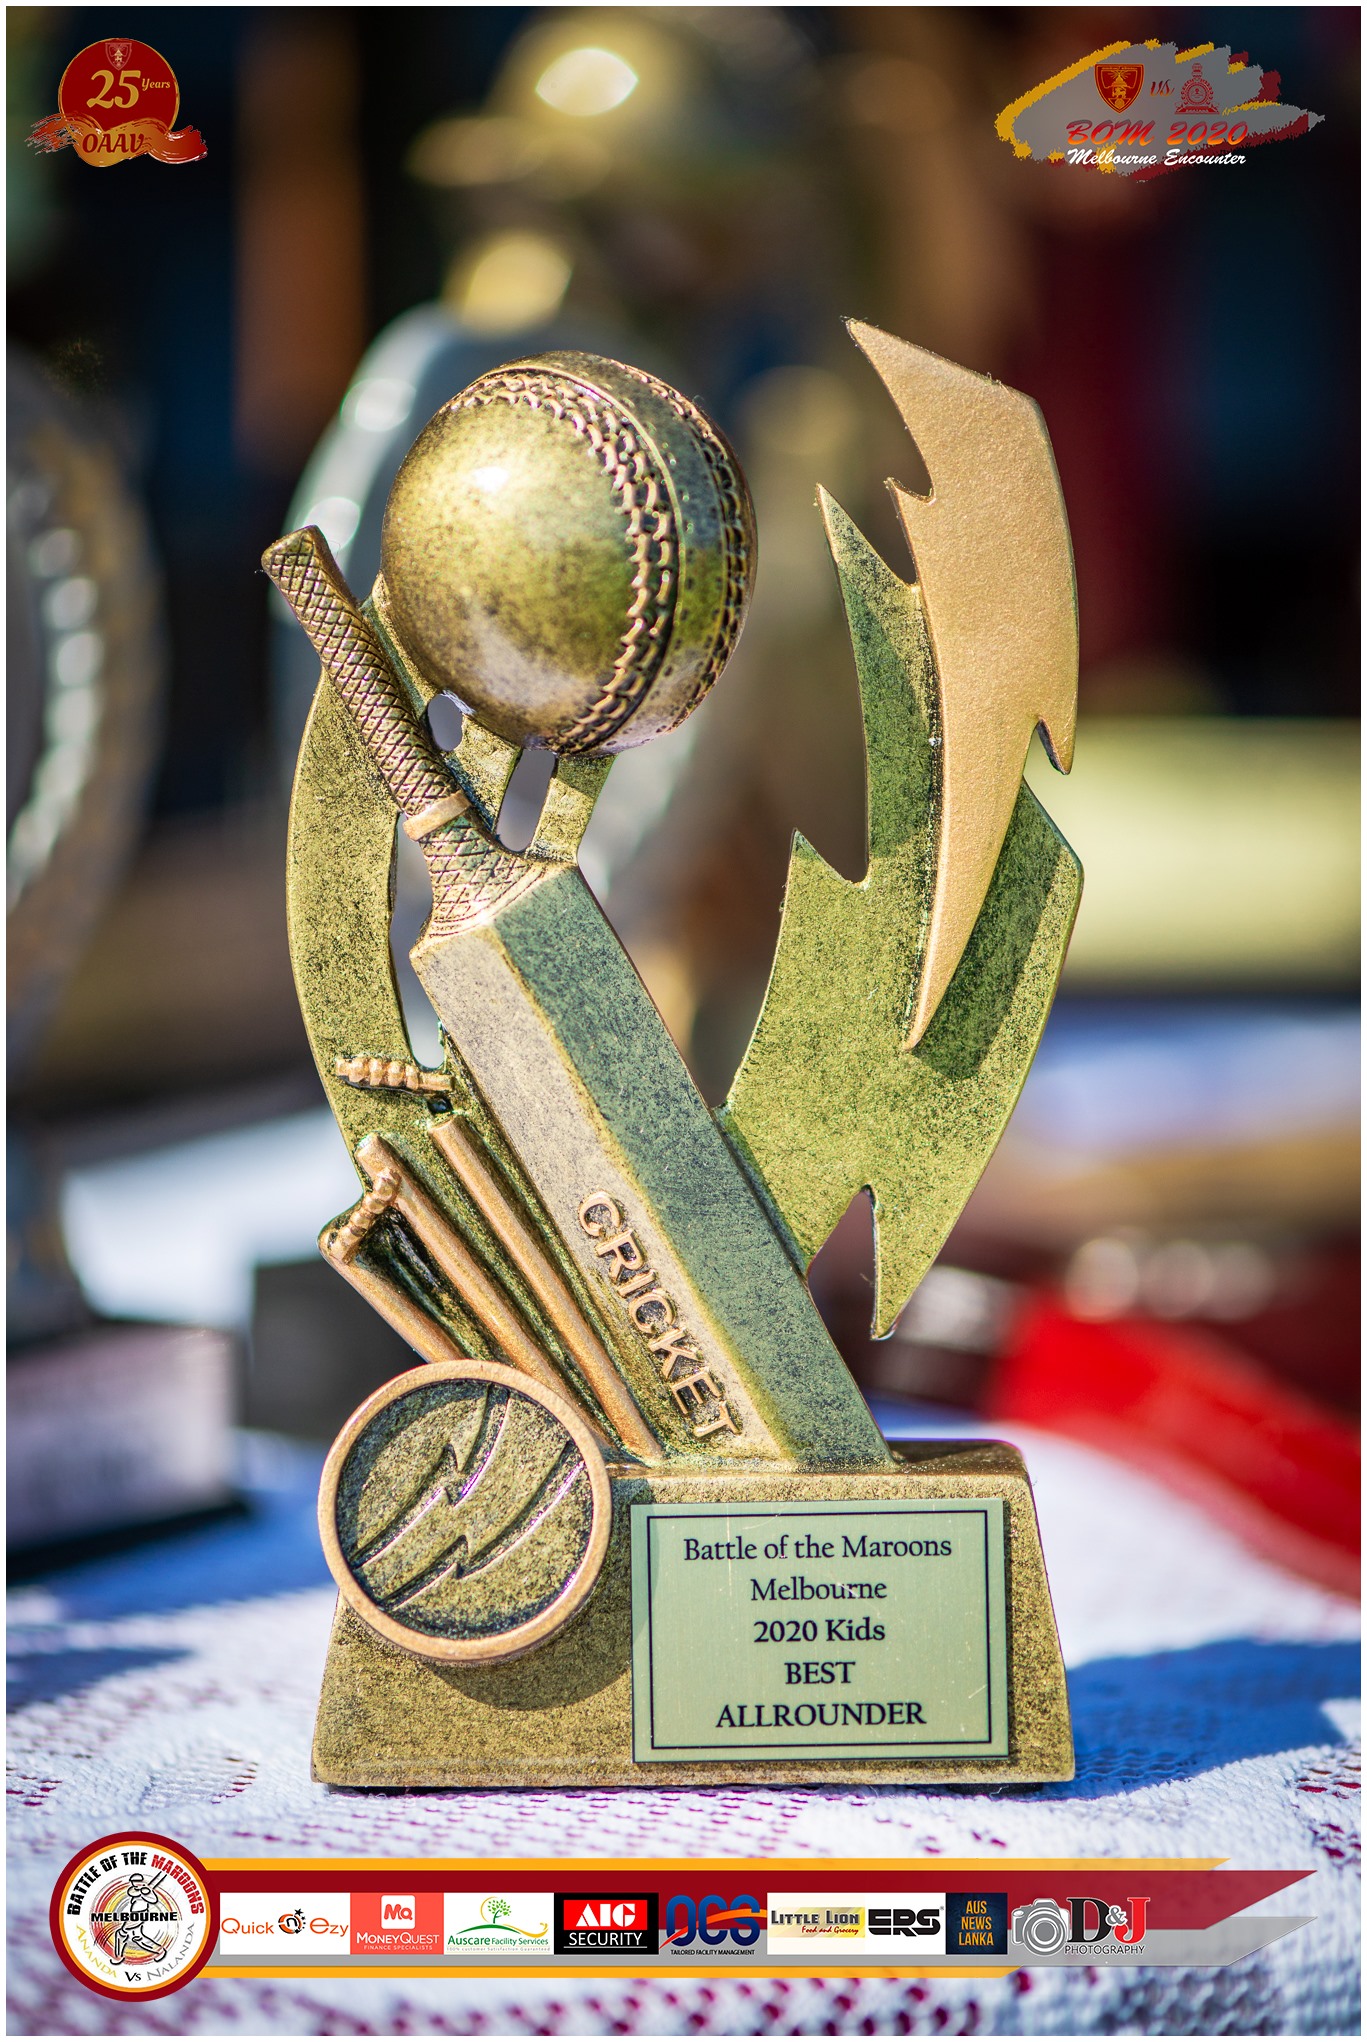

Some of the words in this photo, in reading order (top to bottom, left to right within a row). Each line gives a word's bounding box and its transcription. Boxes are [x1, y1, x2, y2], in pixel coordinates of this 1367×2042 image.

[579, 1190, 743, 1437] CRICKET
[683, 1536, 757, 1561] Battle
[764, 1534, 790, 1559] of
[795, 1534, 835, 1558] the
[841, 1535, 952, 1558] Maroons
[750, 1576, 887, 1601] Melbourne
[753, 1619, 818, 1643] 2020
[826, 1617, 886, 1642] Kids
[784, 1662, 856, 1685] BEST
[715, 1702, 927, 1728] ALLROUNDER
